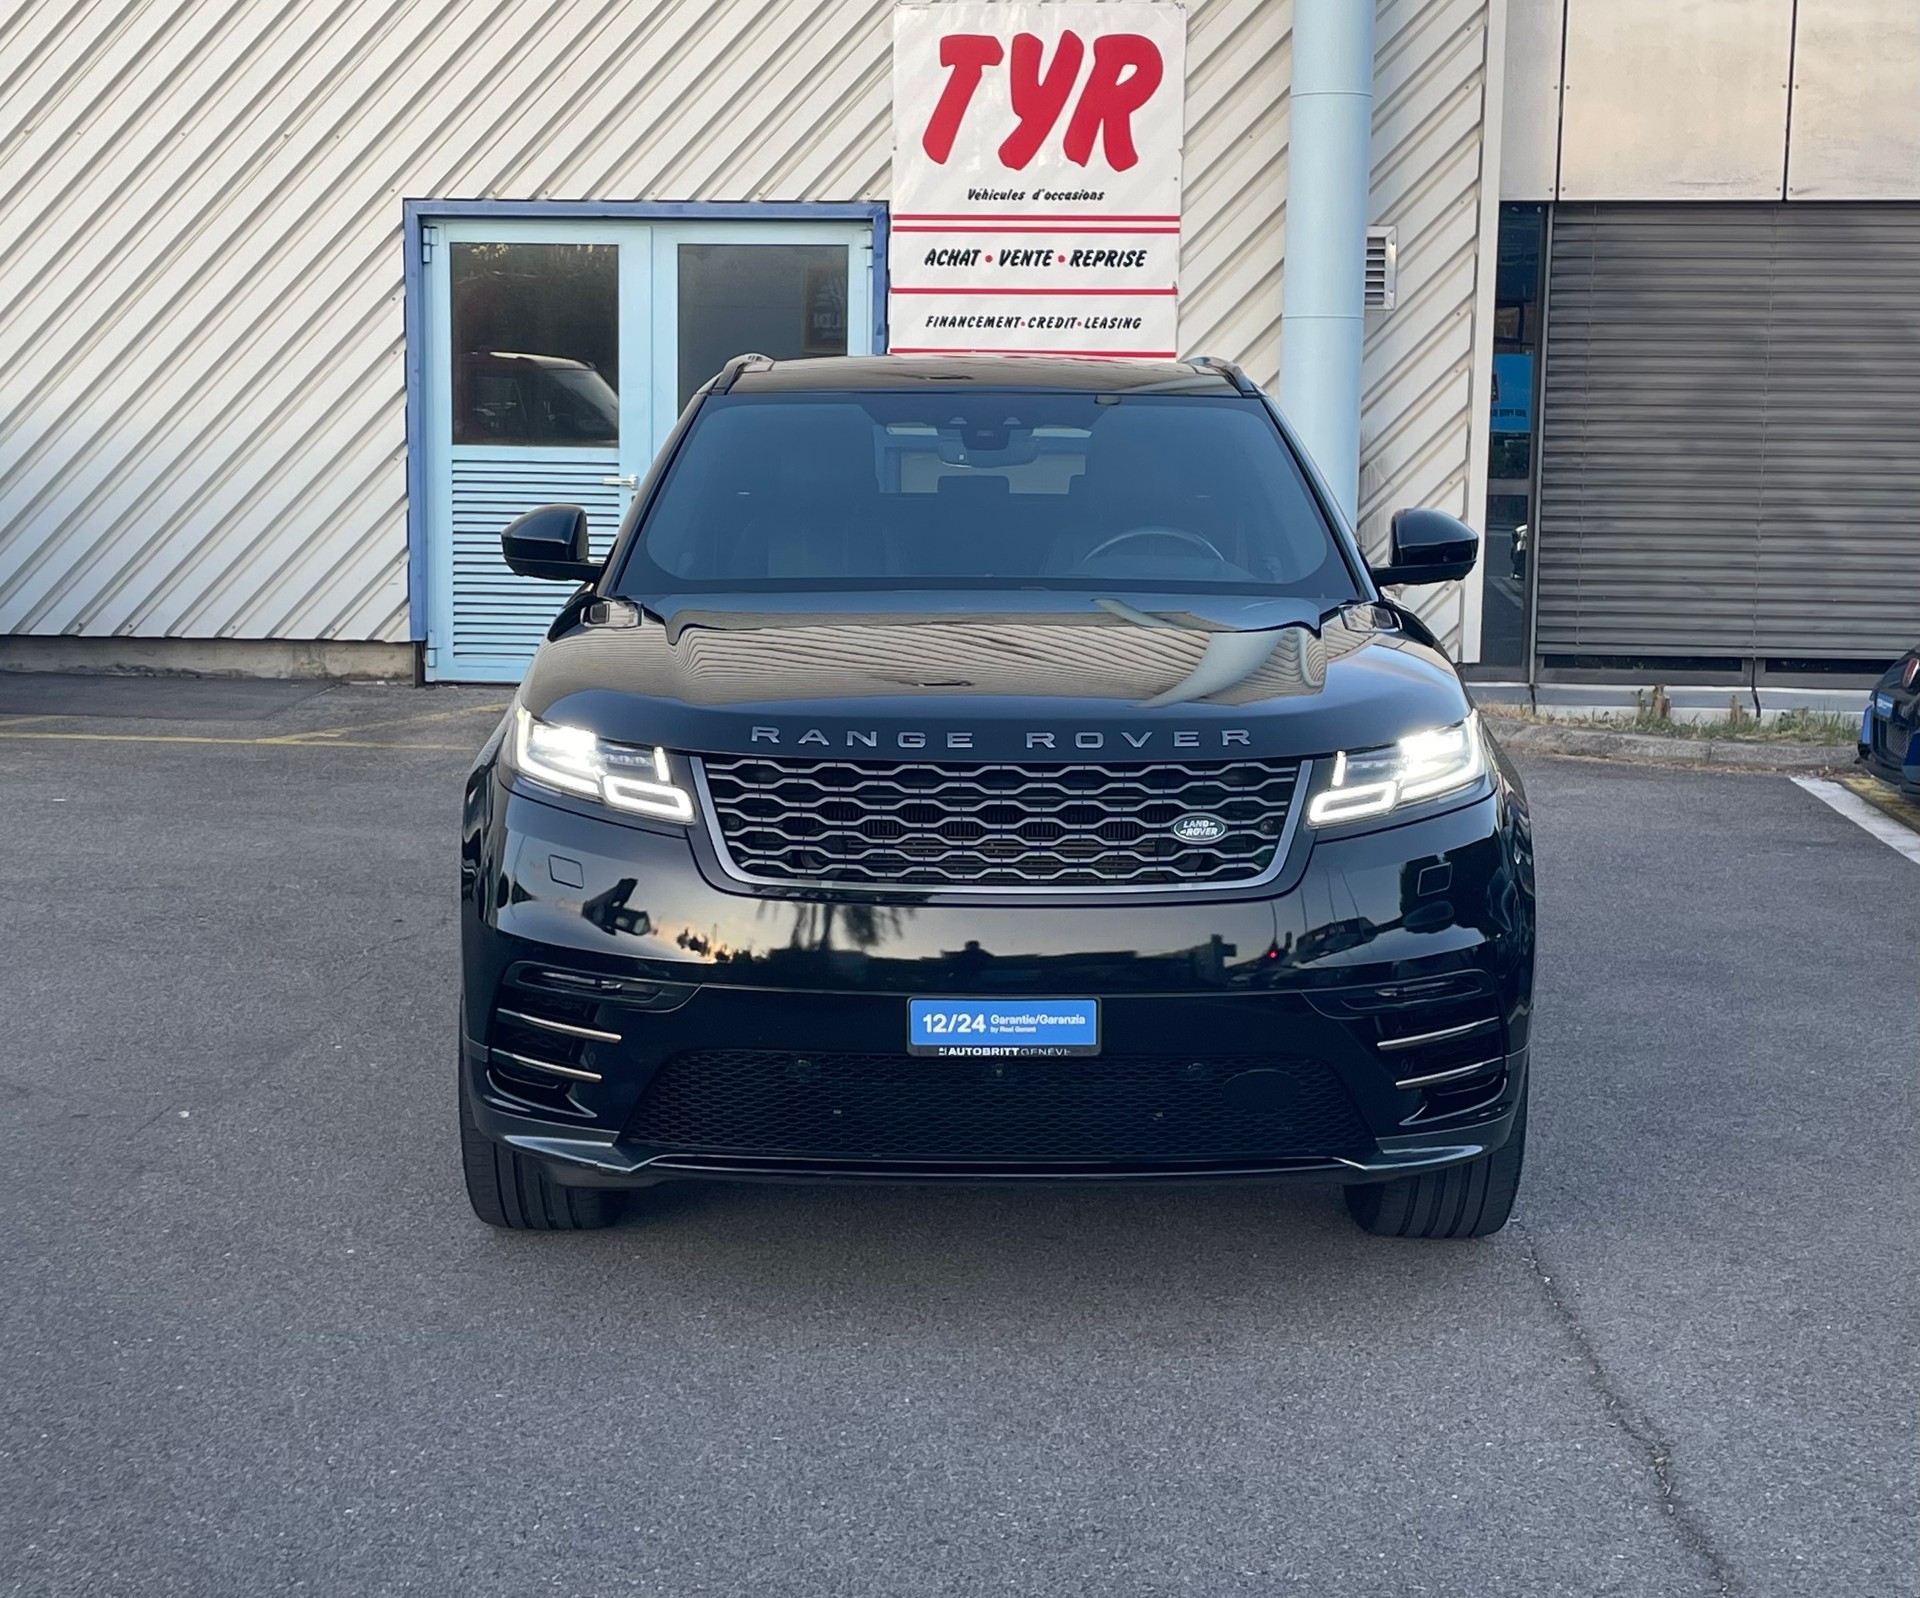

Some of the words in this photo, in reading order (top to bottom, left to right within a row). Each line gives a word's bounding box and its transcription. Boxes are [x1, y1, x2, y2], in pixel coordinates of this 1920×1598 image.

[922, 29, 1164, 172] TYR
[967, 187, 1026, 201] Véhicules
[1032, 188, 1105, 201] d'occasions
[924, 248, 981, 267] ACHAT
[998, 249, 1053, 267] VENTE
[1069, 249, 1147, 268] REPRISE
[925, 315, 1022, 329] FINANCEMENT
[1027, 316, 1078, 329] CREDIT
[1084, 316, 1142, 330] LEASING
[750, 726, 974, 749] RANGE
[1026, 728, 1252, 749] ROVER
[1183, 820, 1209, 828] LAND
[1186, 828, 1218, 836] ROVER
[922, 1014, 986, 1033] 12/24
